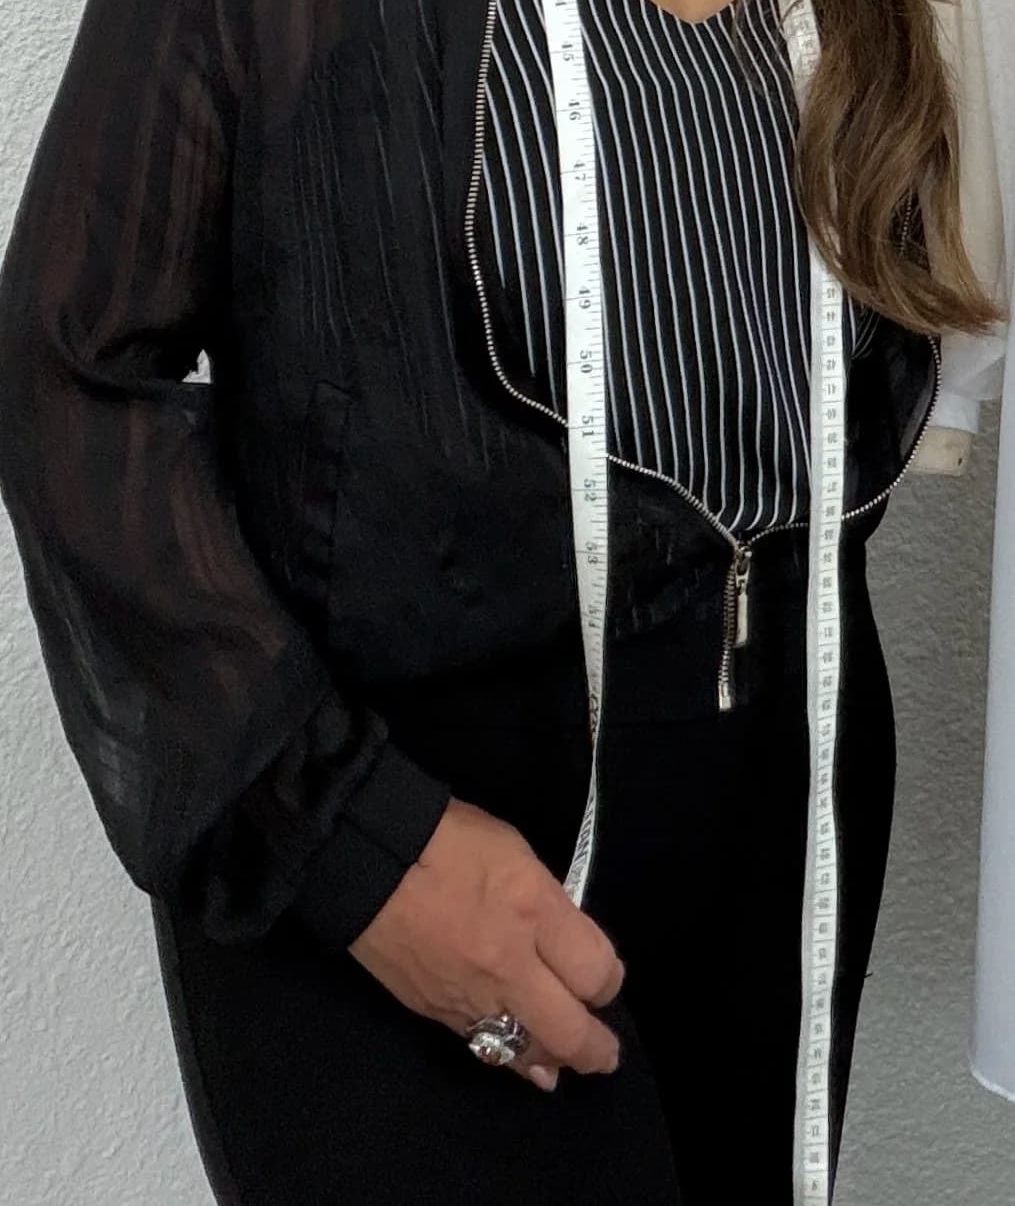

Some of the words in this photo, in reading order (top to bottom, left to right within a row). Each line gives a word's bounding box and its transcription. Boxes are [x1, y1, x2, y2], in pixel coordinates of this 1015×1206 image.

[561, 41, 575, 62] 45
[568, 99, 581, 121] 46
[573, 159, 586, 181] 47
[576, 223, 589, 246] 48
[578, 286, 592, 310] 49
[579, 349, 593, 374] 50
[581, 415, 595, 438] 51
[583, 478, 597, 502] 52
[585, 541, 599, 565] 53
